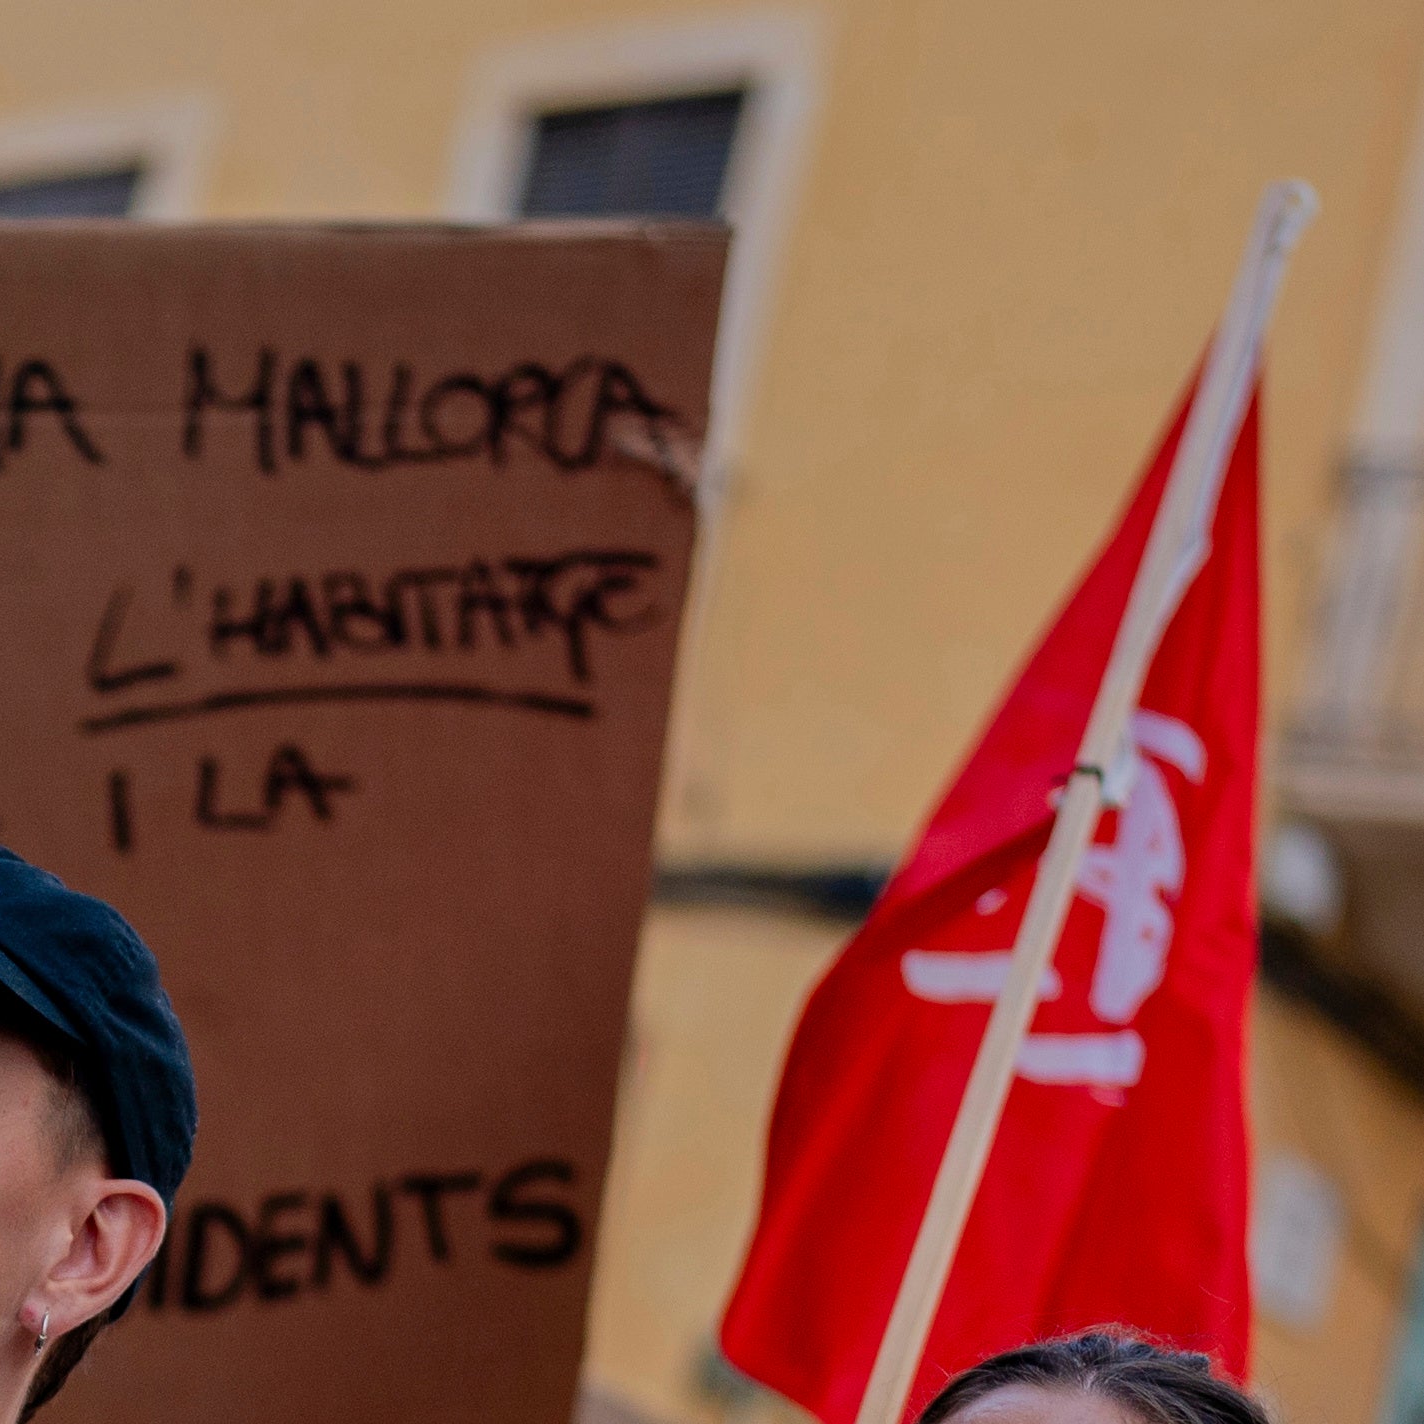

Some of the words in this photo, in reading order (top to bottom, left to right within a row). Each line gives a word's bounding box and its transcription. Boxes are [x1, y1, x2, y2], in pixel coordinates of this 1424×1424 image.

[183, 345, 681, 476] MALLORCA
[108, 768, 135, 856] I
[195, 744, 357, 834] LA
